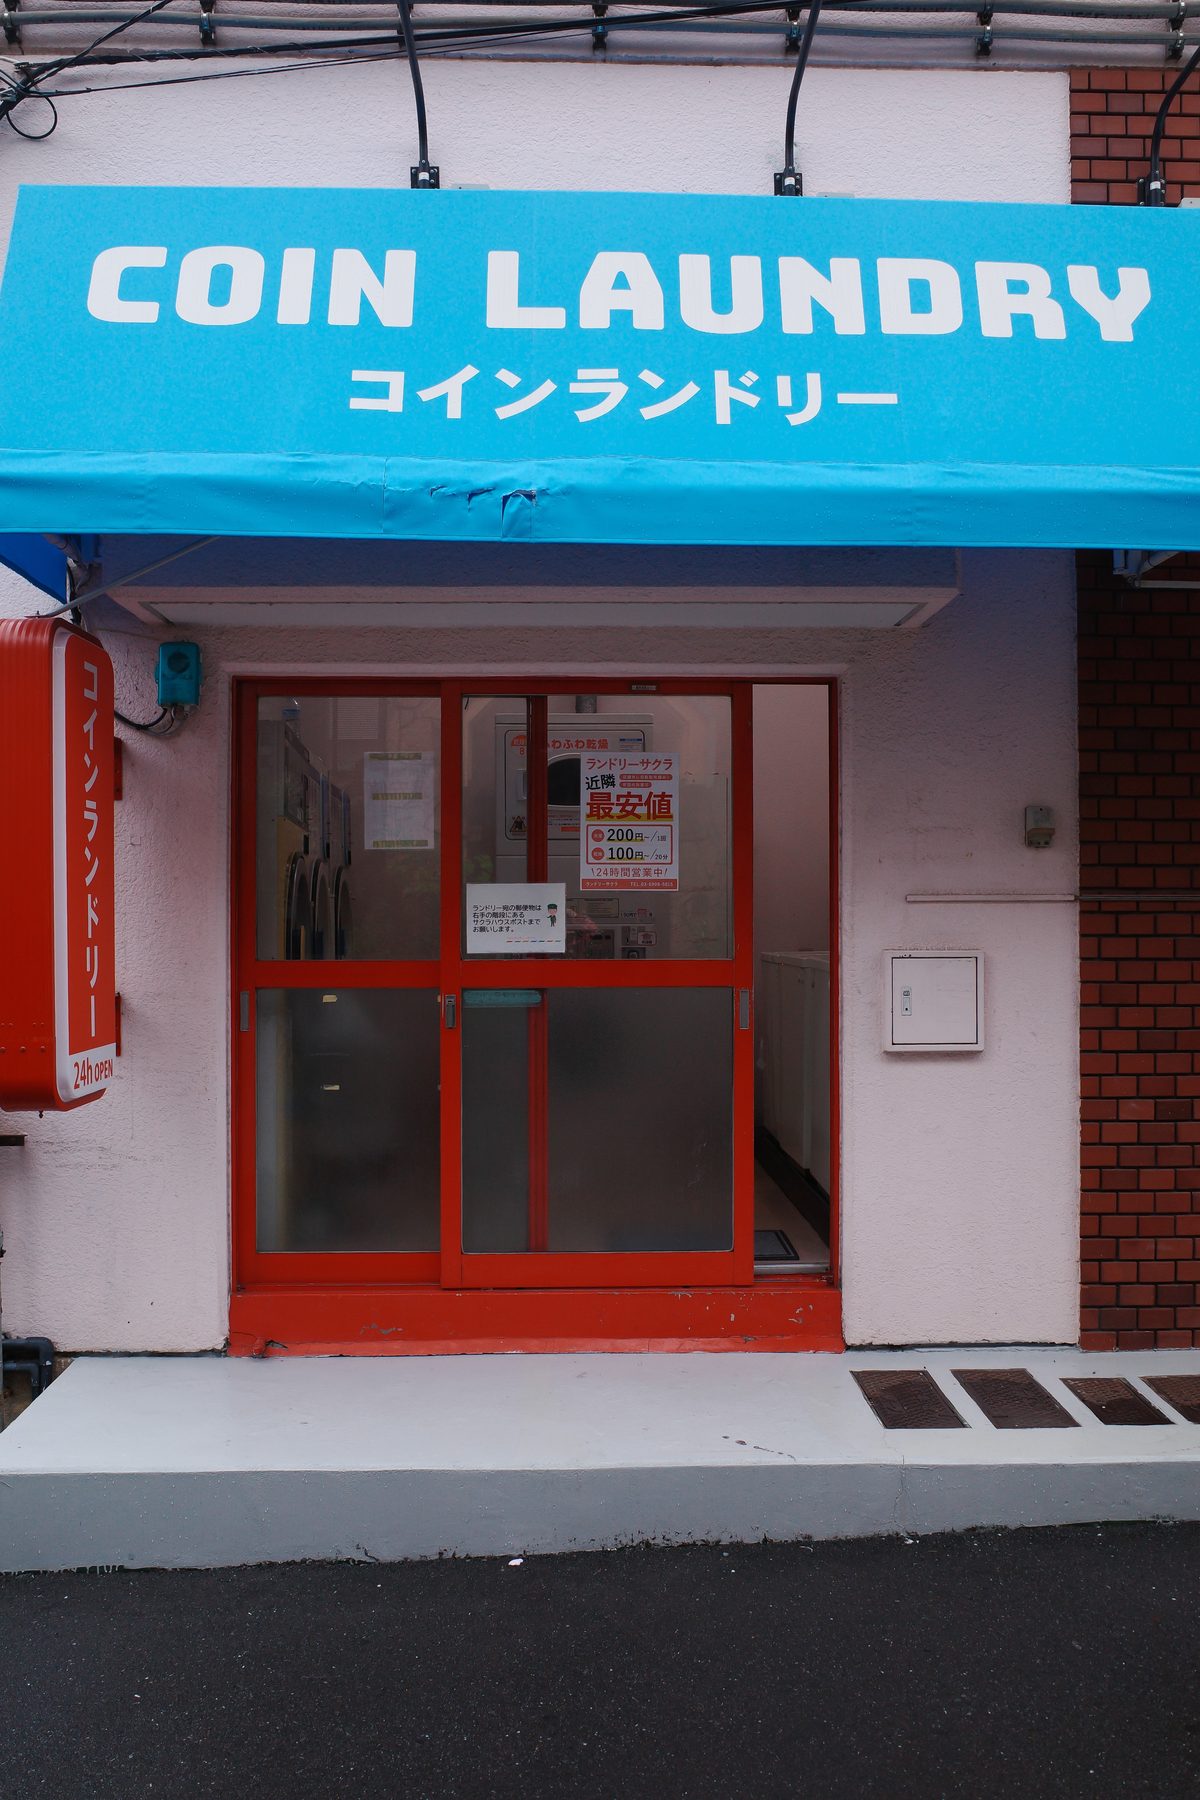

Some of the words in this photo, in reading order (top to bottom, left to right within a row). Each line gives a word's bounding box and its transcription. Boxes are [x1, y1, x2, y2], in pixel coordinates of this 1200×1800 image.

[86, 245, 416, 328] COIN
[485, 250, 1152, 343] LAUNDRY
[348, 364, 899, 427] コインランドリー
[586, 758, 673, 771] ランドリーサクラ
[585, 773, 616, 791] 近隣
[586, 791, 673, 820] 最安値
[83, 660, 100, 1038] コインランドリー
[73, 1056, 93, 1090] 24h
[94, 1059, 113, 1082] OPEN
